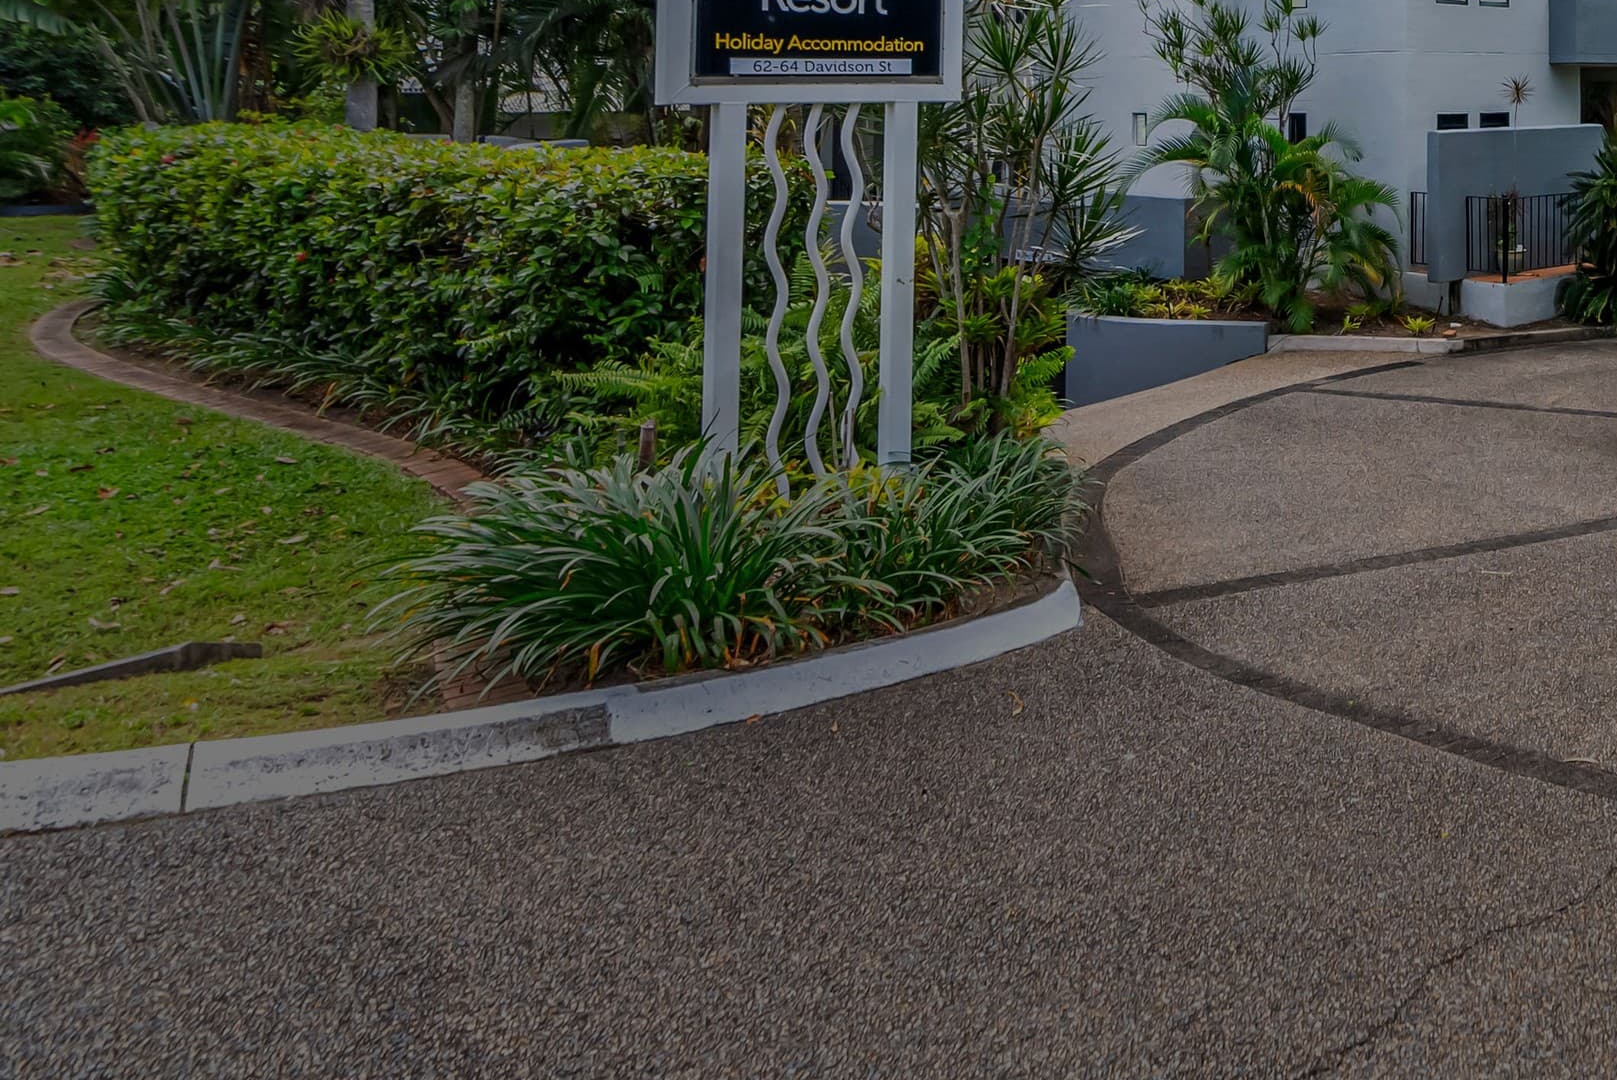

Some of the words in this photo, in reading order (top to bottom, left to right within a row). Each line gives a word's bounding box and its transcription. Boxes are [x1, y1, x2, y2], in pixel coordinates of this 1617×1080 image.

[715, 32, 783, 54] Holiday
[787, 35, 924, 53] Accommodation
[752, 60, 799, 73] 62-64
[804, 60, 875, 73] Davidson
[879, 60, 893, 73] St
